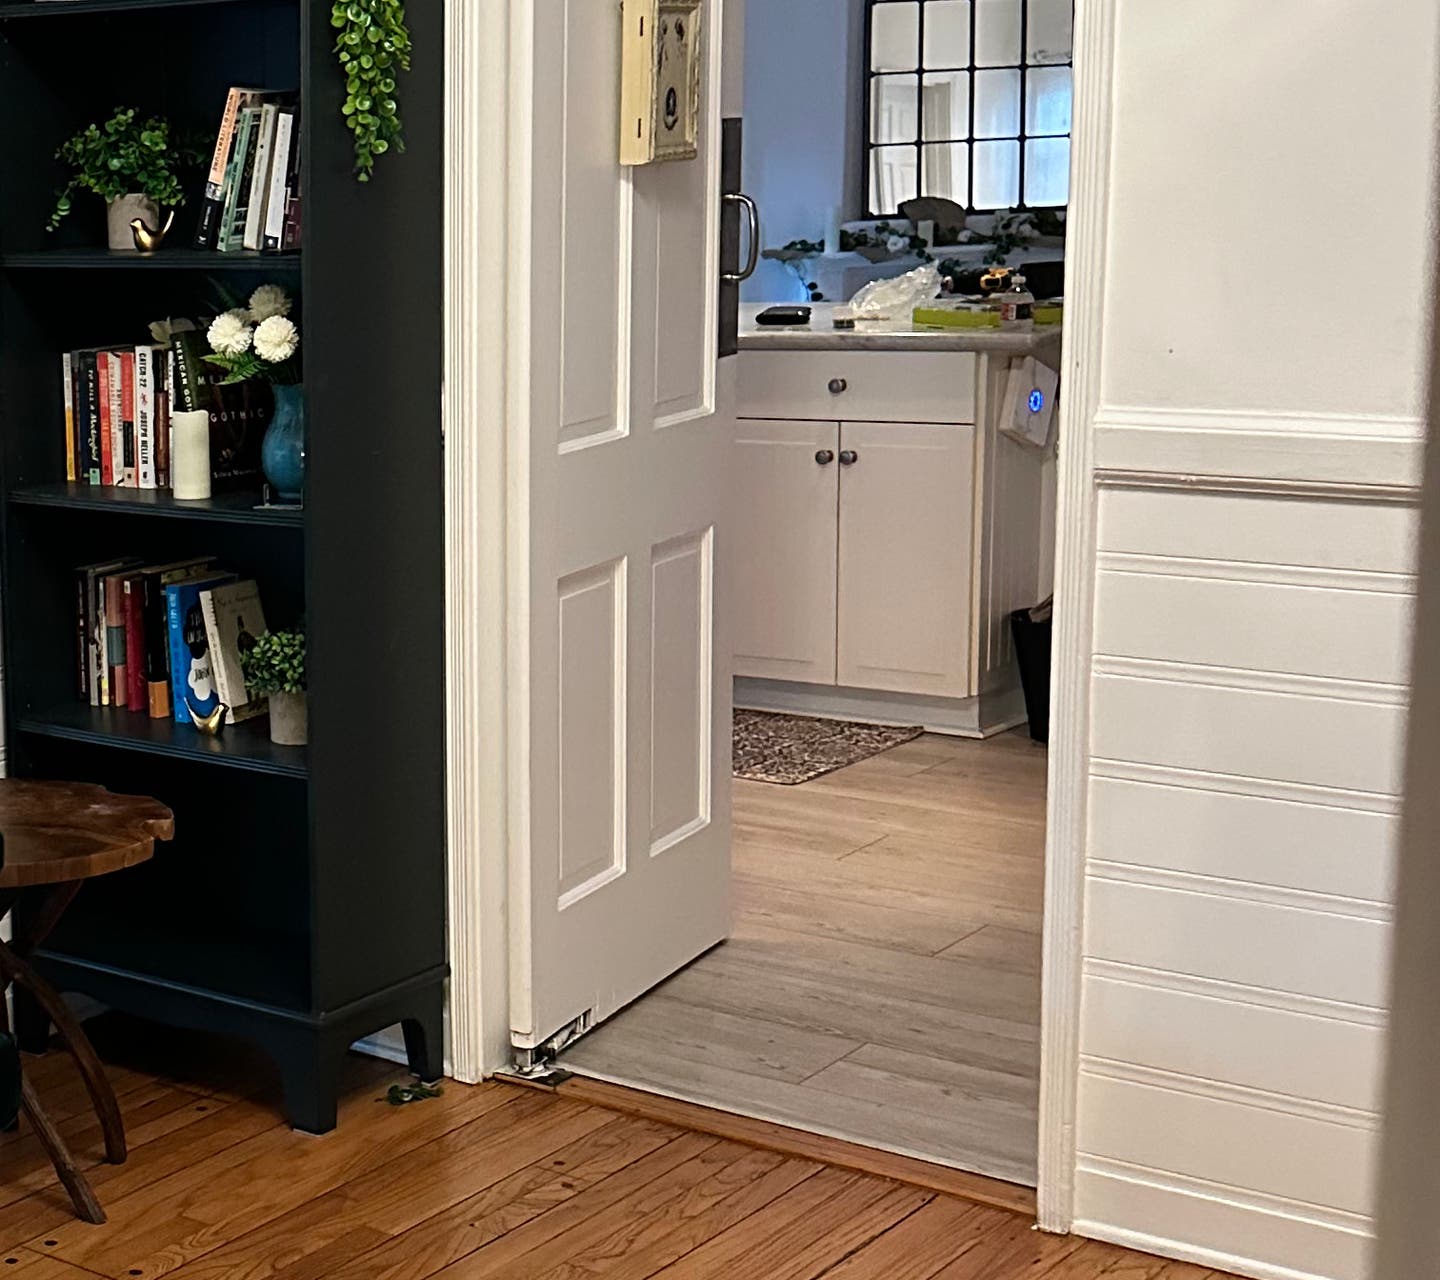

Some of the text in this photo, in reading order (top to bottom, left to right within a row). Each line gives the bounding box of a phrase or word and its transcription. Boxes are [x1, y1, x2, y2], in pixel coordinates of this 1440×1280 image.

[213, 94, 234, 172] WORLD LITERATURE
[87, 369, 94, 379] TO
[174, 340, 188, 385] MEXICAN
[140, 410, 148, 438] JOSEPH
[209, 408, 265, 423] GOTHIC
